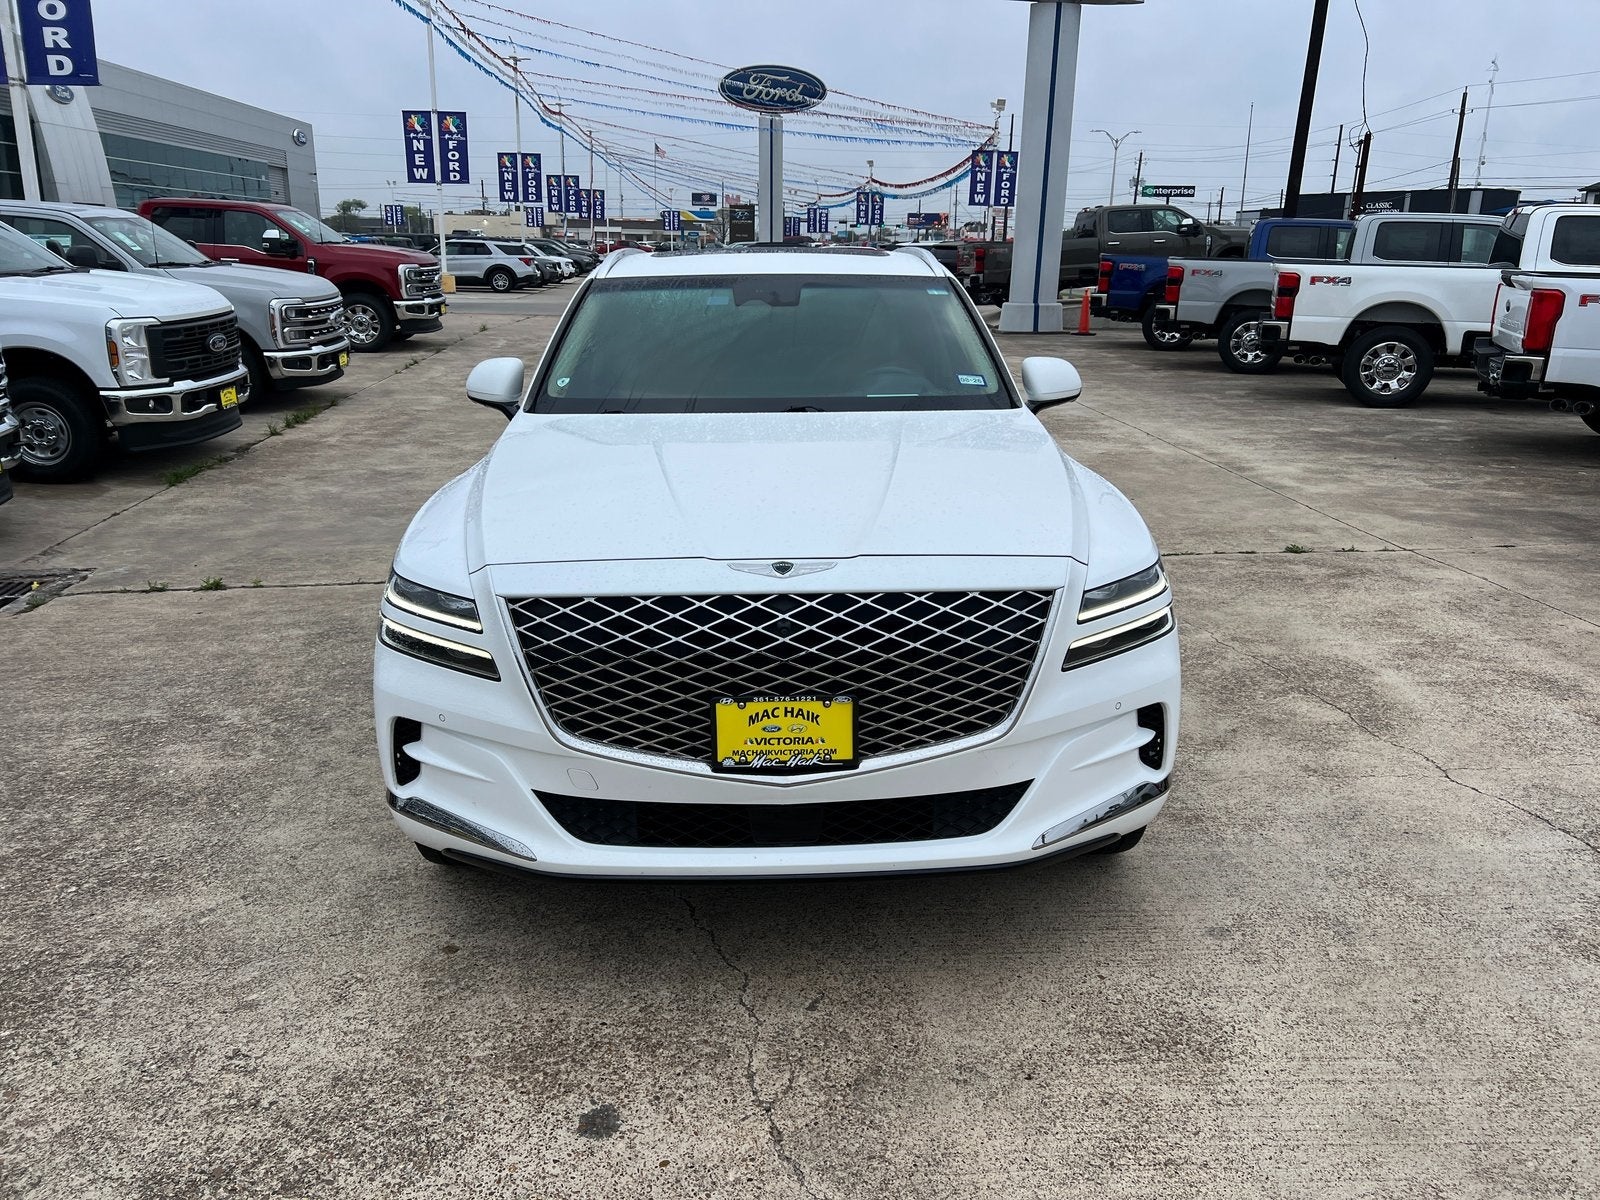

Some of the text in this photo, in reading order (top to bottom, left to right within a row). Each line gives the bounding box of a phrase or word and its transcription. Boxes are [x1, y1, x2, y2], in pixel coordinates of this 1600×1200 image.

[743, 73, 803, 102] Ford
[412, 139, 428, 179] NEW
[447, 140, 460, 181] FORD
[503, 172, 514, 200] NEW
[527, 173, 537, 201] FORD
[974, 172, 986, 203] NEW
[1000, 173, 1010, 204] FORD
[1144, 187, 1195, 196] enterprise
[551, 189, 560, 211] NEW
[1191, 268, 1222, 277] FX4
[1309, 275, 1352, 285] FX4
[748, 706, 821, 727] MAC HAIK
[754, 736, 815, 746] VICTORIA
[750, 753, 823, 768] Mac Haik
